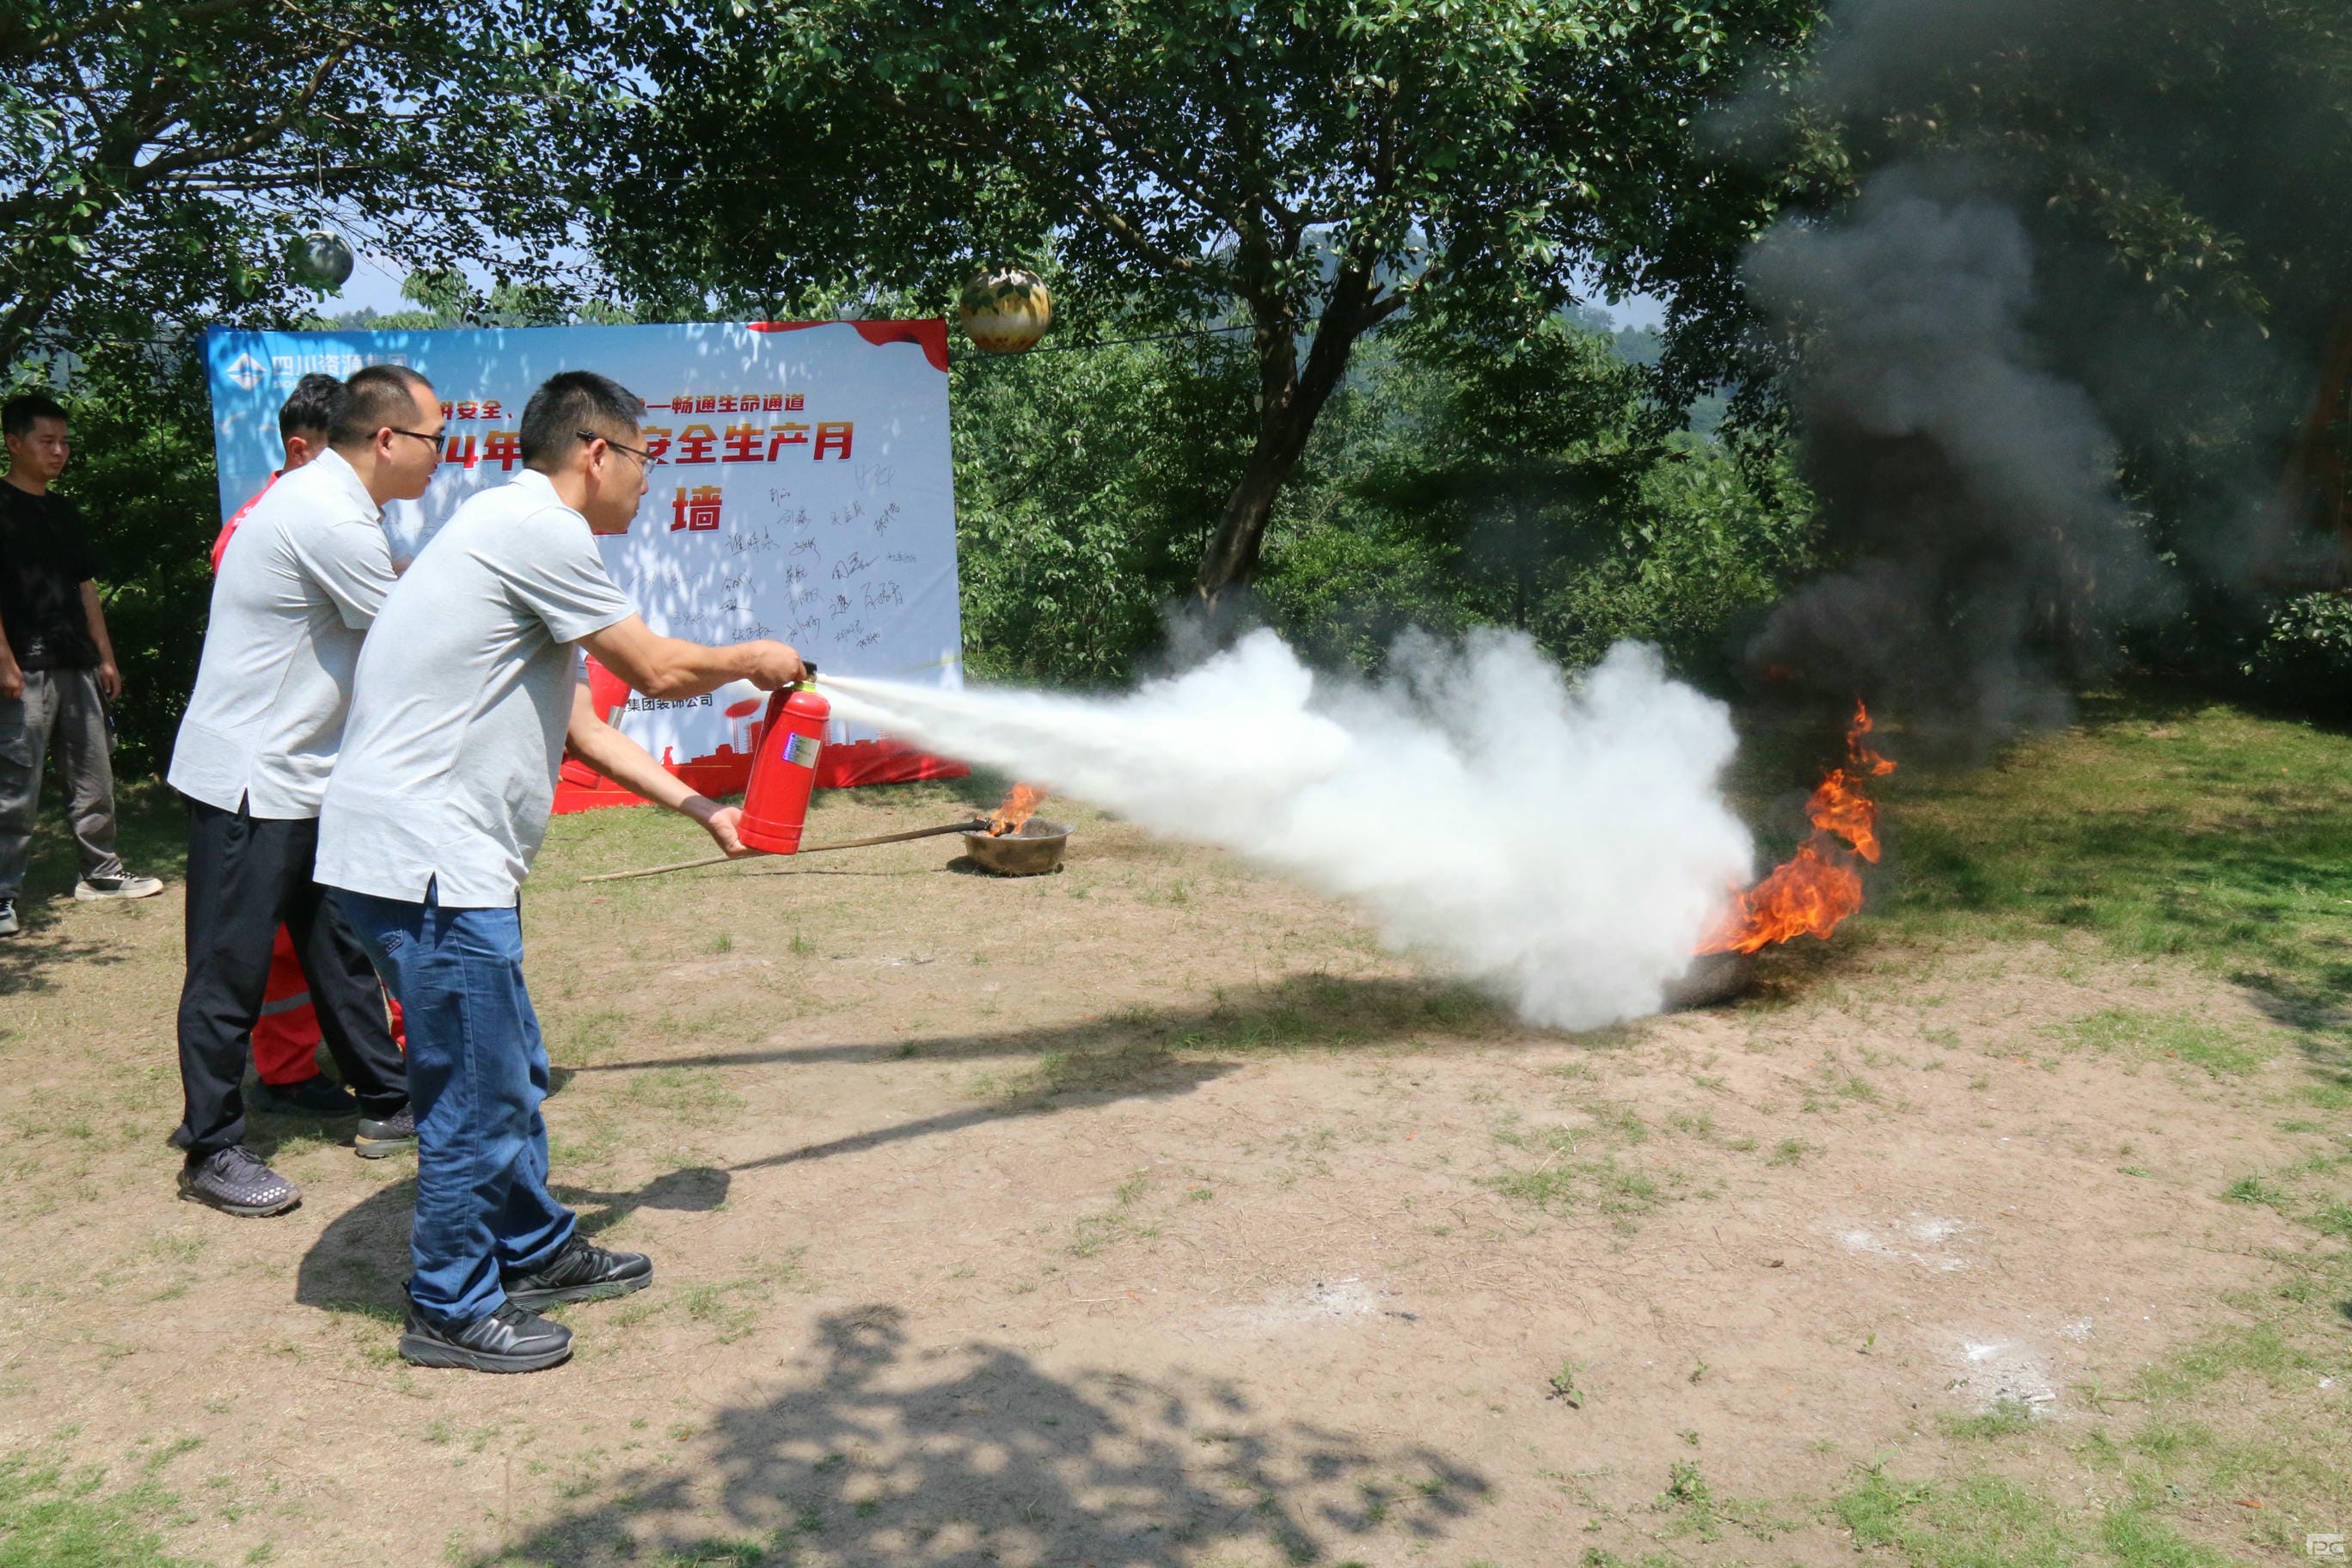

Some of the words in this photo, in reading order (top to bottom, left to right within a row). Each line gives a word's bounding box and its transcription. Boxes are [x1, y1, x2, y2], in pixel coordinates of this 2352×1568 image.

[639, 393, 805, 414] —畅通生命通道
[434, 431, 523, 471] 4年
[644, 421, 854, 465] 安全生产月
[671, 485, 723, 532] 墙
[625, 693, 713, 713] 集团装饰公司
